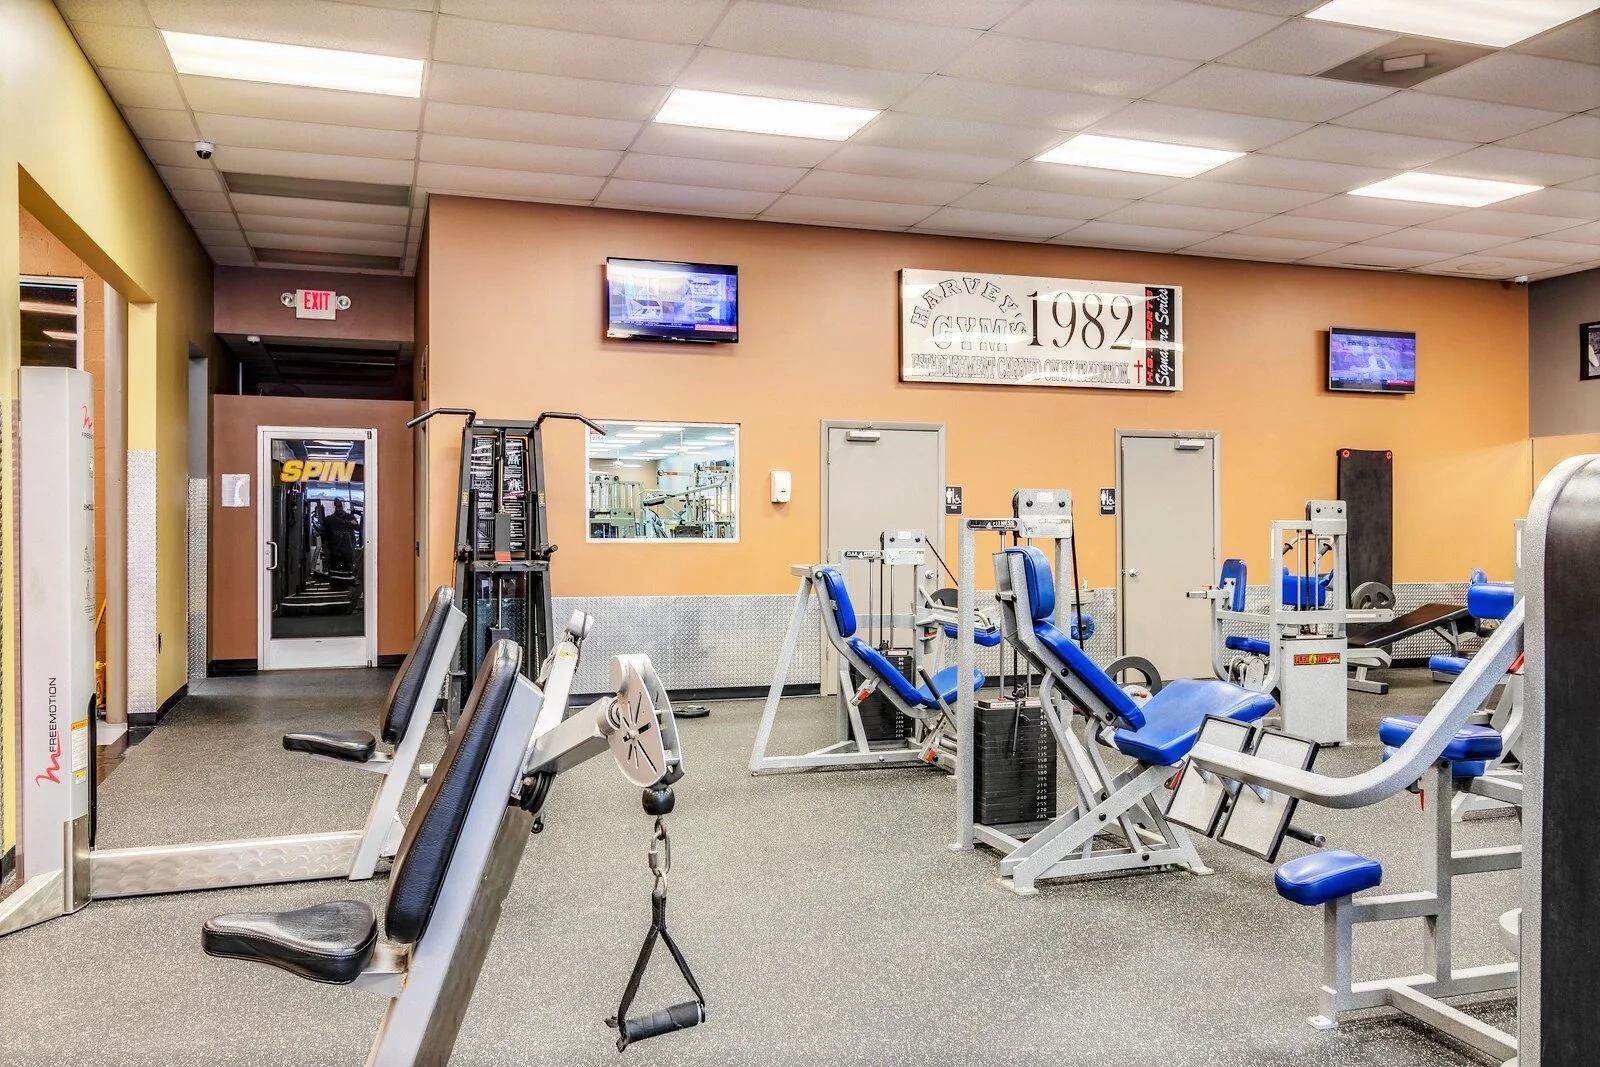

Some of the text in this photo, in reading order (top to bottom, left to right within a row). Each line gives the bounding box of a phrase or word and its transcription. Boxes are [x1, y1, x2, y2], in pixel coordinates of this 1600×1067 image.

[303, 291, 331, 311] EXIT
[910, 277, 1027, 337] HARVEY'S
[1155, 288, 1170, 326] Series
[932, 314, 1008, 351] GYM
[1027, 290, 1134, 350] 1982
[998, 356, 1041, 381] CARRIED
[279, 460, 357, 483] SPIN
[49, 677, 57, 753] FREEMOTION
